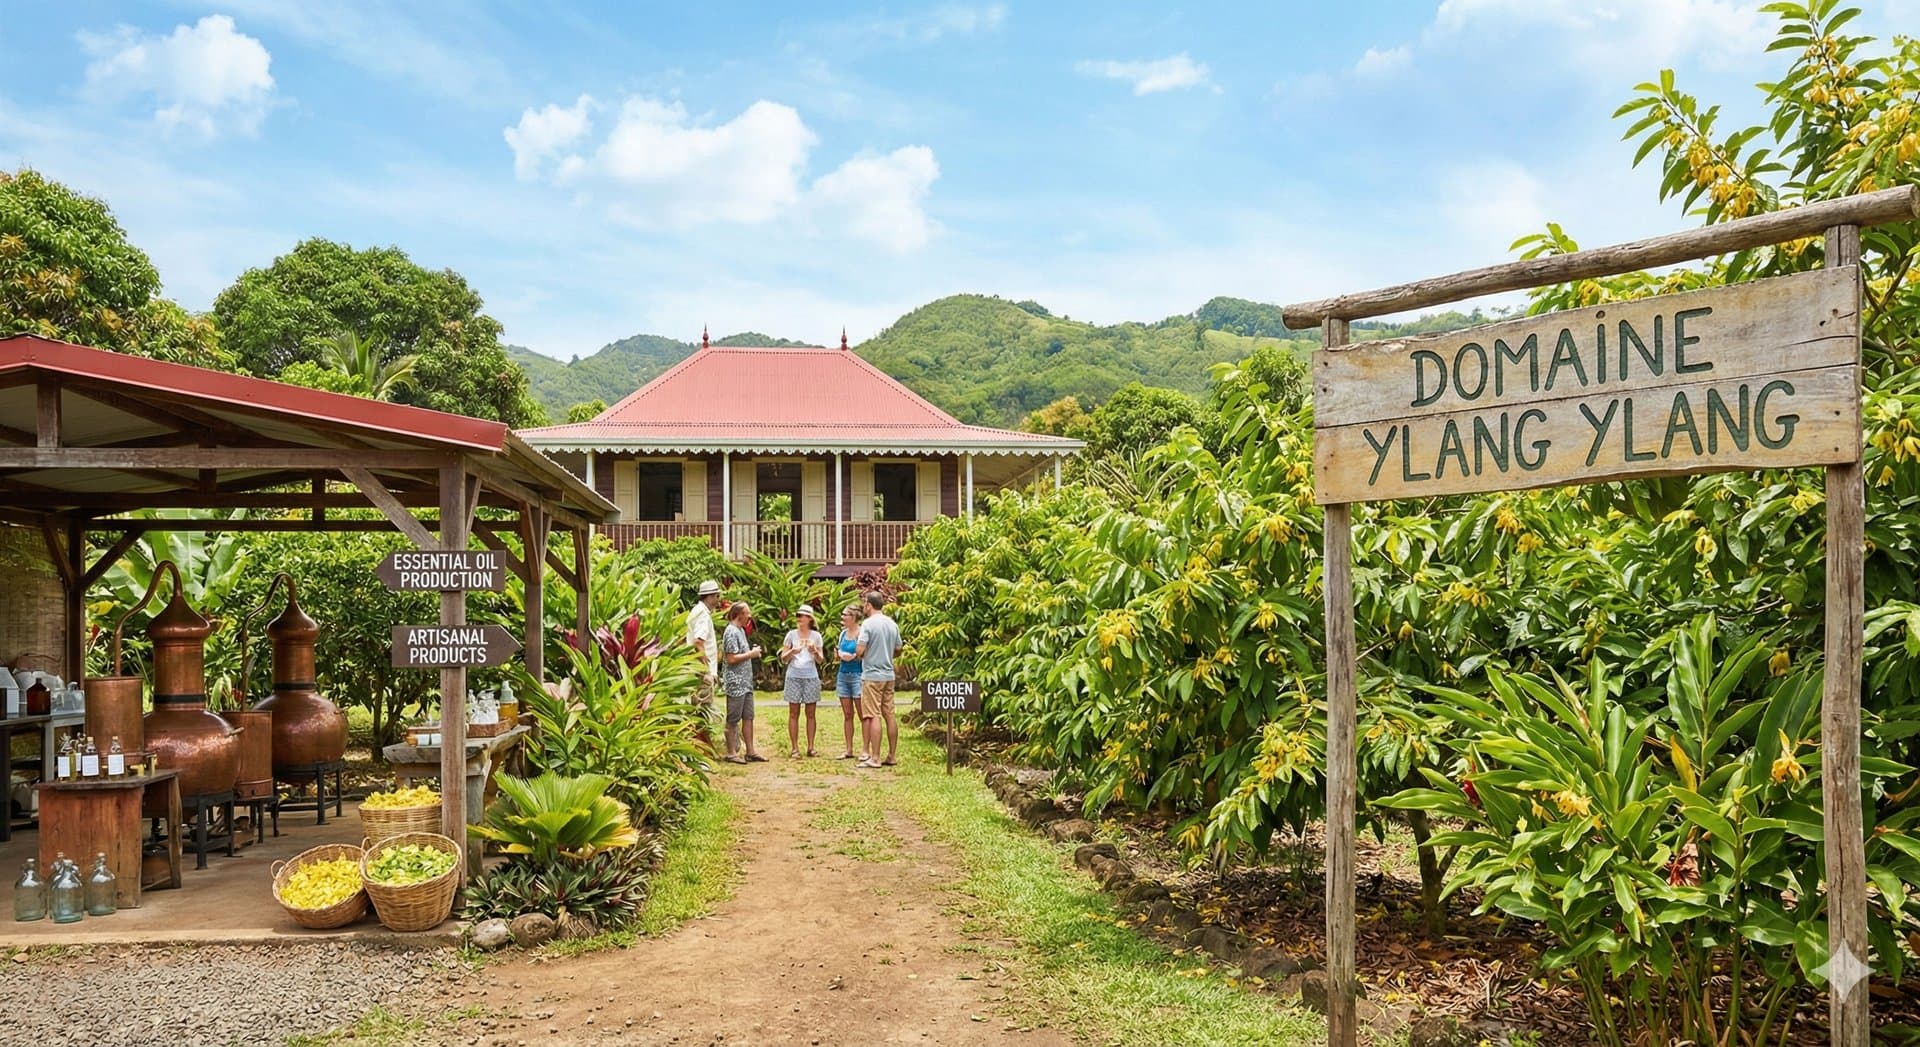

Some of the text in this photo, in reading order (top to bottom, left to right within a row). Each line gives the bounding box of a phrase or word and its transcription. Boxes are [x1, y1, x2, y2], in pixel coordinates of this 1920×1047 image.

[1363, 379, 1800, 486] YLANG YLANG
[393, 553, 499, 570] ESSENTIAL OIL
[400, 571, 493, 588] PRODUCTION
[407, 628, 489, 646] ARTISANAL
[409, 646, 487, 664] PRODUCTS
[927, 681, 973, 696] GARDEN
[934, 695, 966, 710] TOUR
